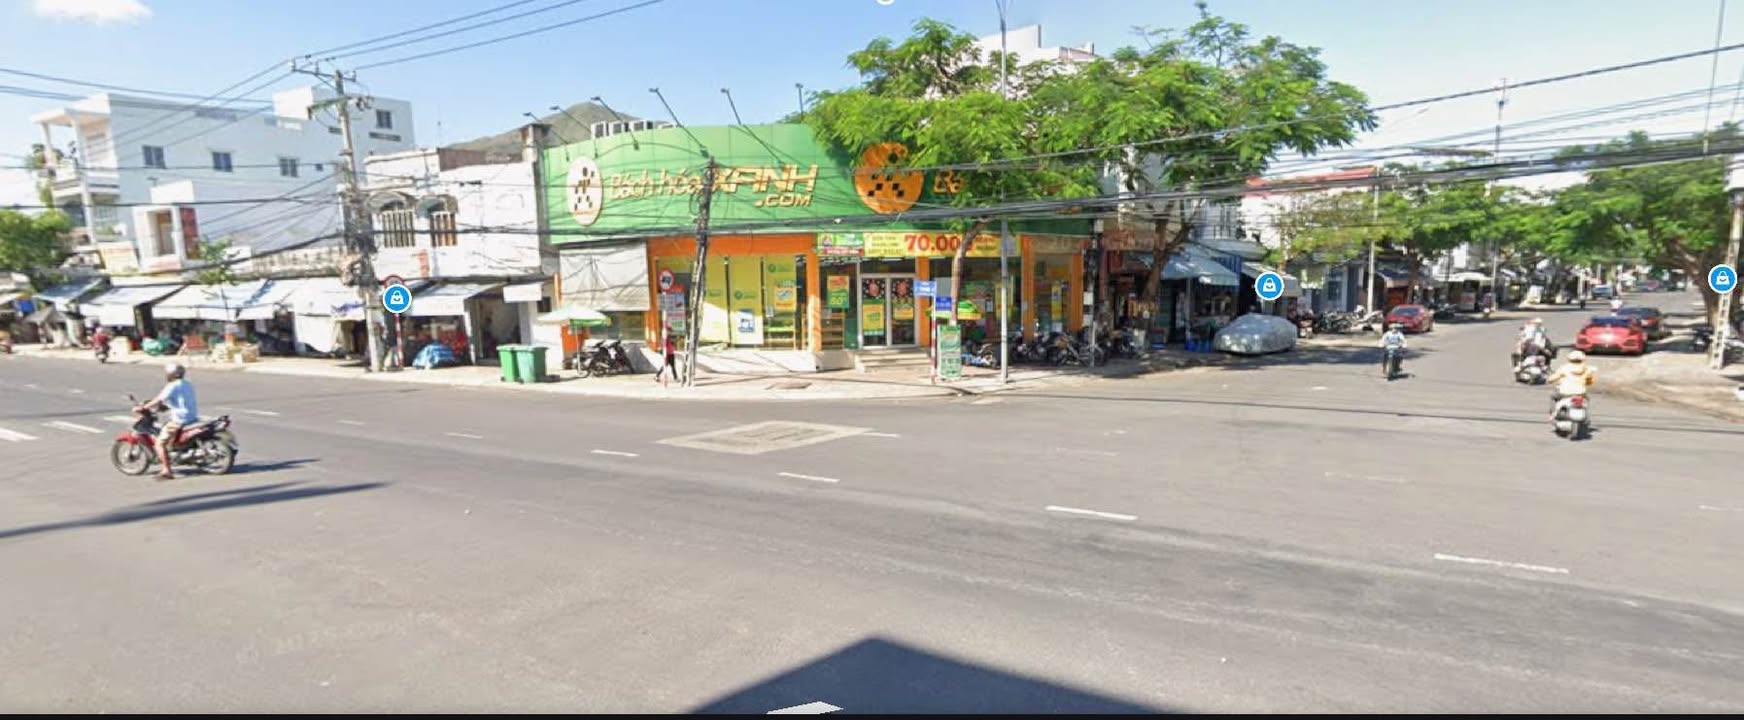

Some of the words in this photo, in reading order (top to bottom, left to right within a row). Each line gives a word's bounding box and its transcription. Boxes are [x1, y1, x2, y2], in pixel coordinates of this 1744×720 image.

[608, 169, 656, 200] Bách
[711, 164, 819, 194] XANH
[754, 193, 813, 208] .COM
[905, 233, 974, 252] 70.00
